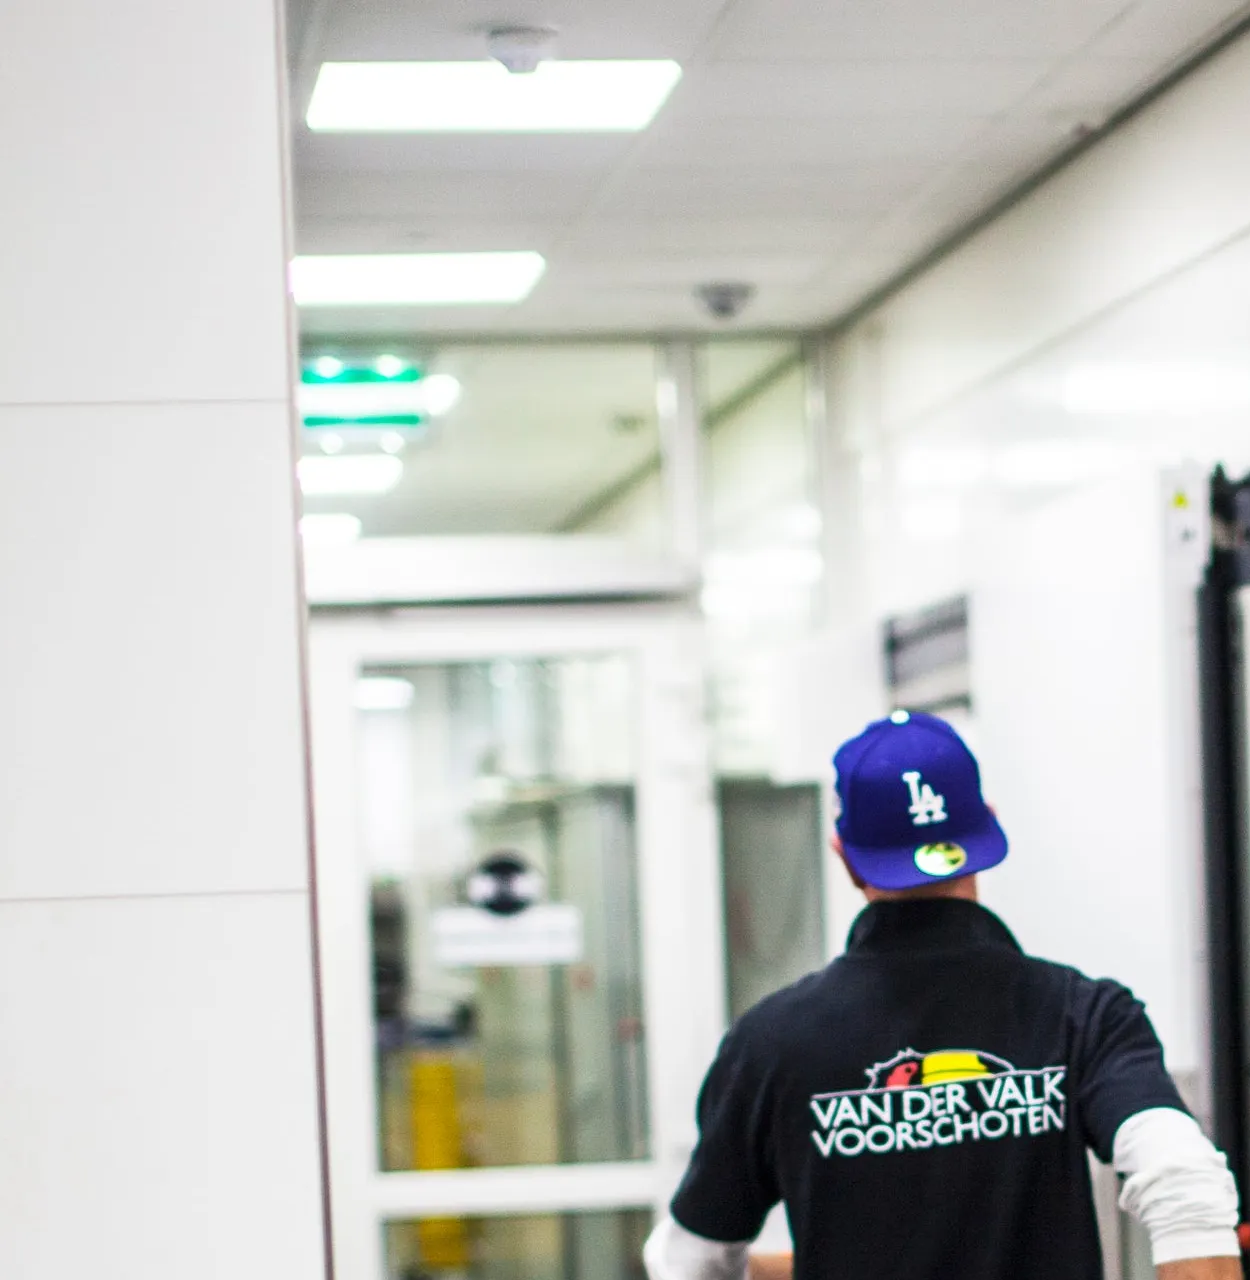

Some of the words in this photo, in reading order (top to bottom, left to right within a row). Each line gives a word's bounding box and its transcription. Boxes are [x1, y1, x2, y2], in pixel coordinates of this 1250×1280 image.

[902, 771, 947, 824] LA
[810, 1093, 891, 1129] VAN
[902, 1083, 970, 1121] DER
[977, 1071, 1065, 1109] VALK
[811, 1103, 1065, 1157] VOORSCHOTEN
